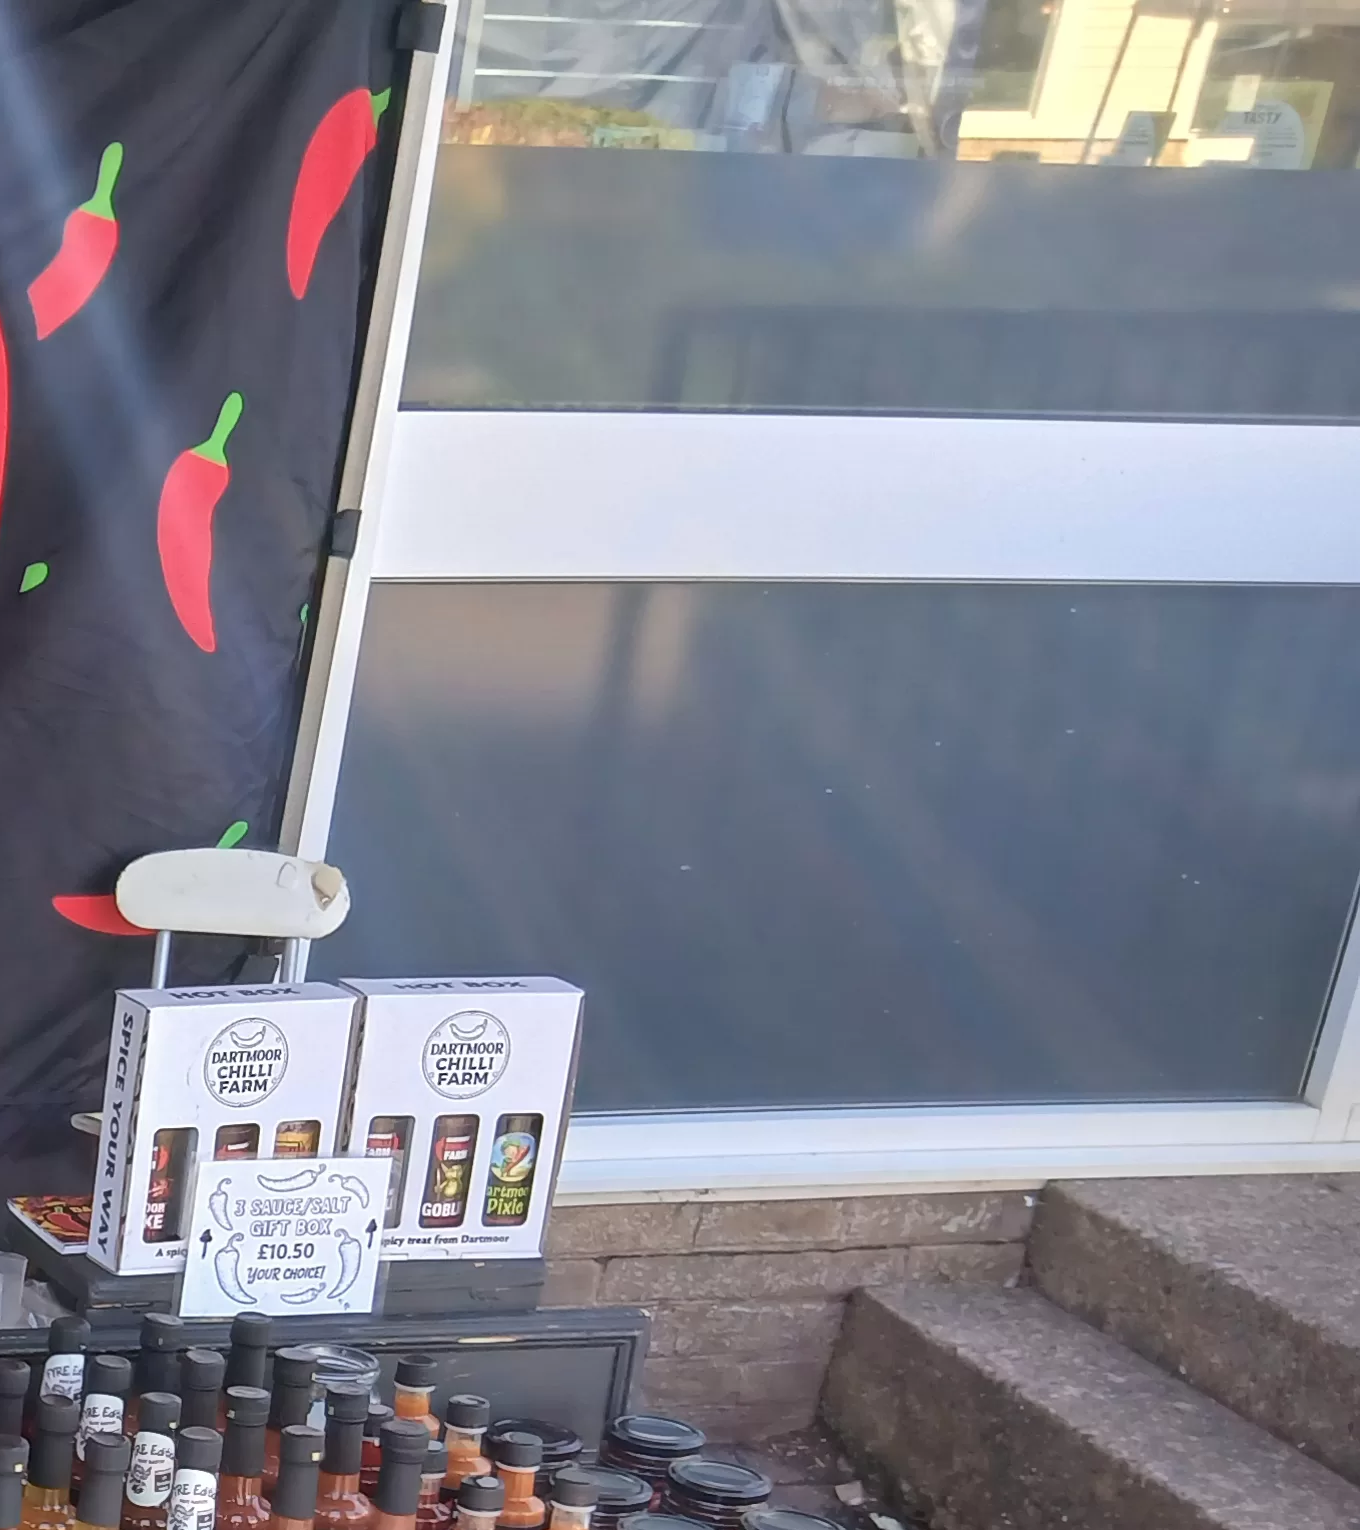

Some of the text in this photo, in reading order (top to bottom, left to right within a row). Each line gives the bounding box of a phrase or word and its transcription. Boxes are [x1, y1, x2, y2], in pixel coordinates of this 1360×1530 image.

[170, 987, 301, 1000] HOT BOX
[431, 1042, 503, 1055] DARTMOOR
[212, 1049, 282, 1064] DARTMOOR
[217, 1064, 273, 1078] CHILLI
[436, 1057, 494, 1071] CHILLI
[437, 1072, 489, 1085] FARM
[219, 1079, 268, 1095] FARM
[97, 1012, 133, 1256] SPICE YOUR WAY
[234, 1196, 351, 1217] 3 SAUCE/SALT
[250, 1219, 332, 1237] GIFT BOX
[407, 1235, 510, 1244] treat from Dartmoor
[156, 1248, 163, 1257] A
[257, 1243, 314, 1260] £10.50
[248, 1268, 280, 1284] YOUR
